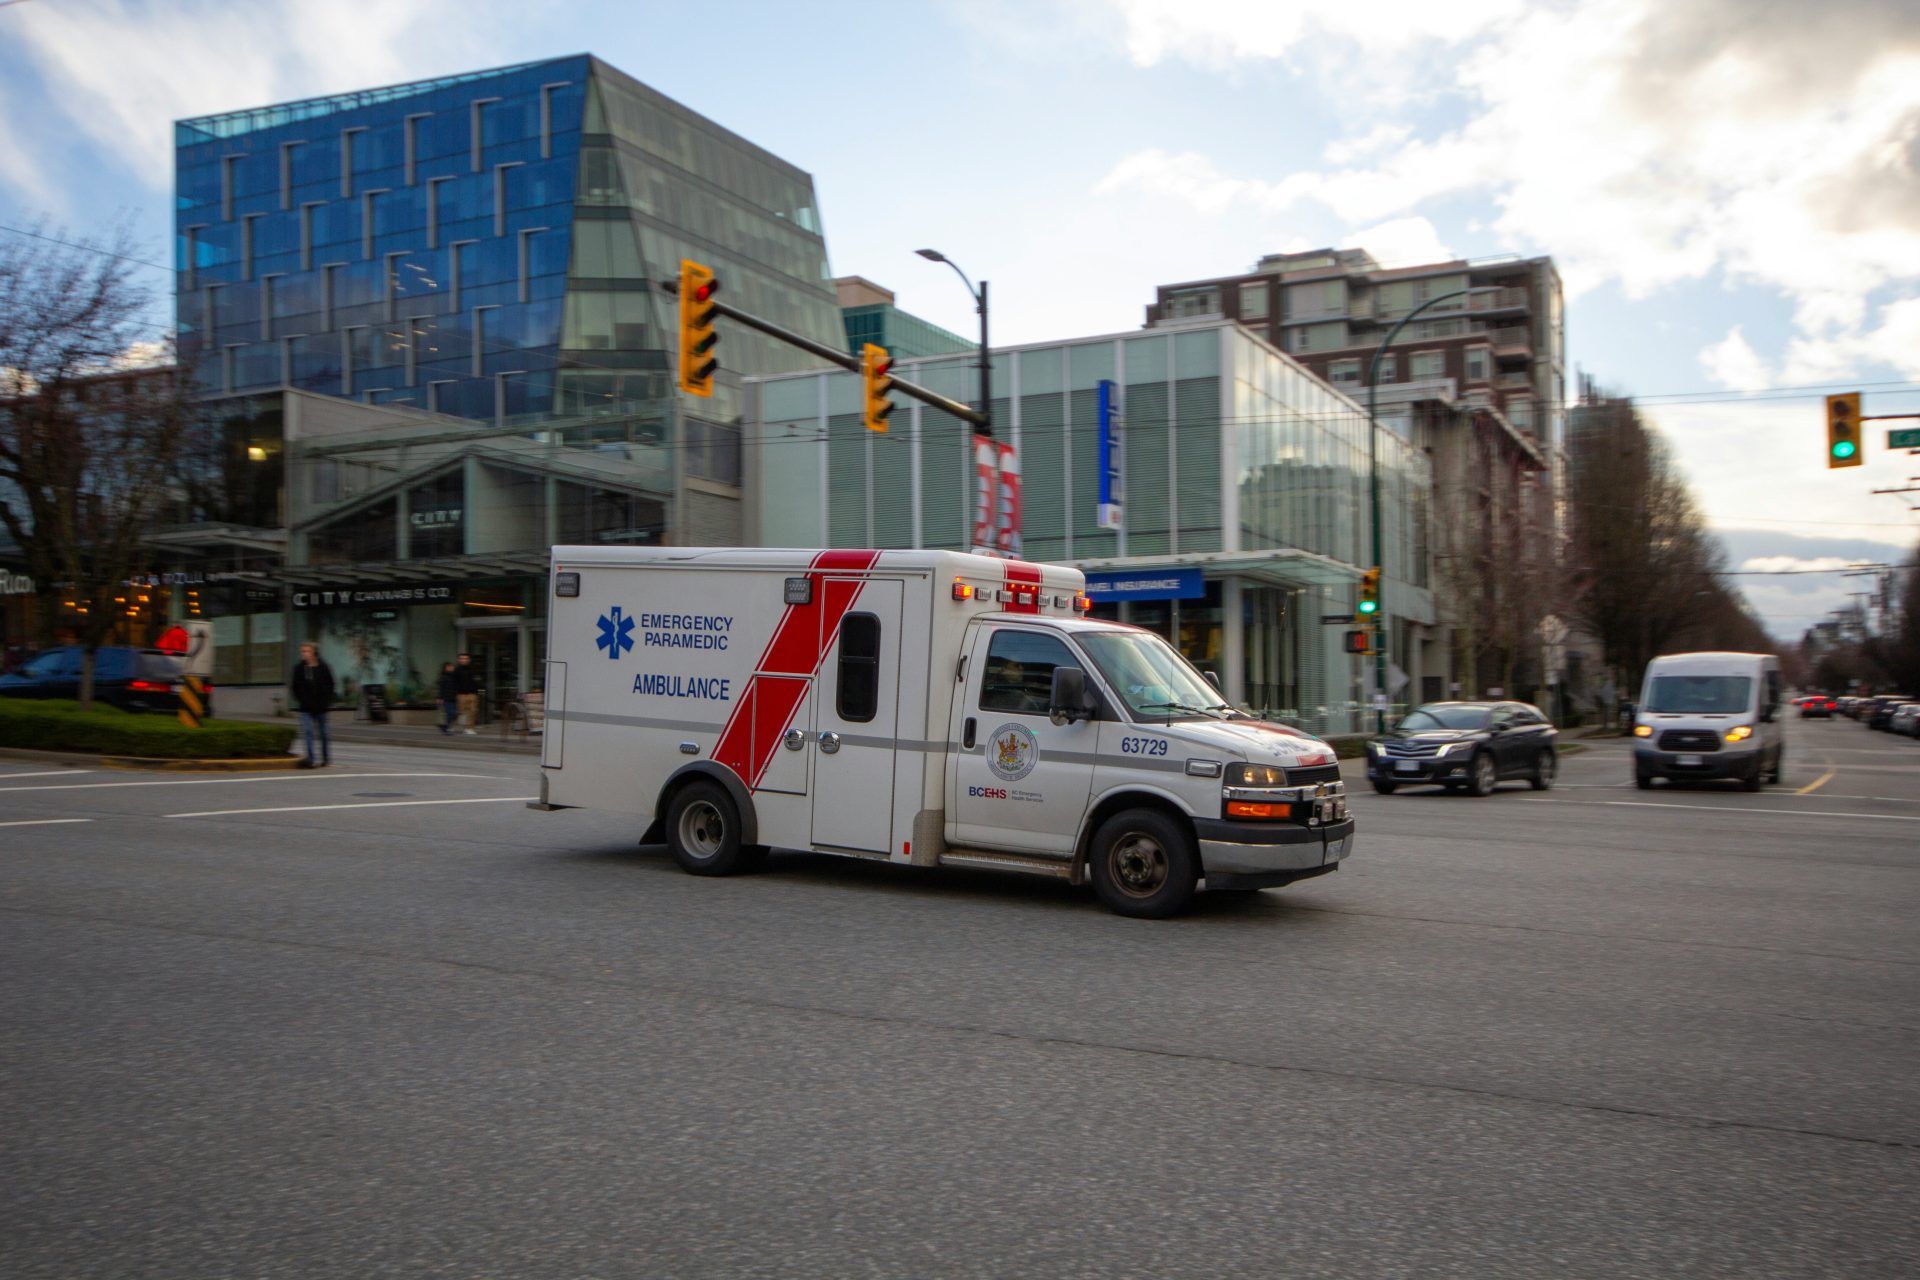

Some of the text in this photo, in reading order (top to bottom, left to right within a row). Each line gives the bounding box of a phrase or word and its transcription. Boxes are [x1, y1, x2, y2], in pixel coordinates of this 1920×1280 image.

[292, 591, 352, 606] CITY
[641, 613, 734, 632] EMERGENCY
[644, 632, 729, 651] PARAMEDIC
[632, 673, 731, 701] AMBULANCE
[1121, 737, 1168, 756] 63729
[968, 786, 1007, 799] BCEHS
